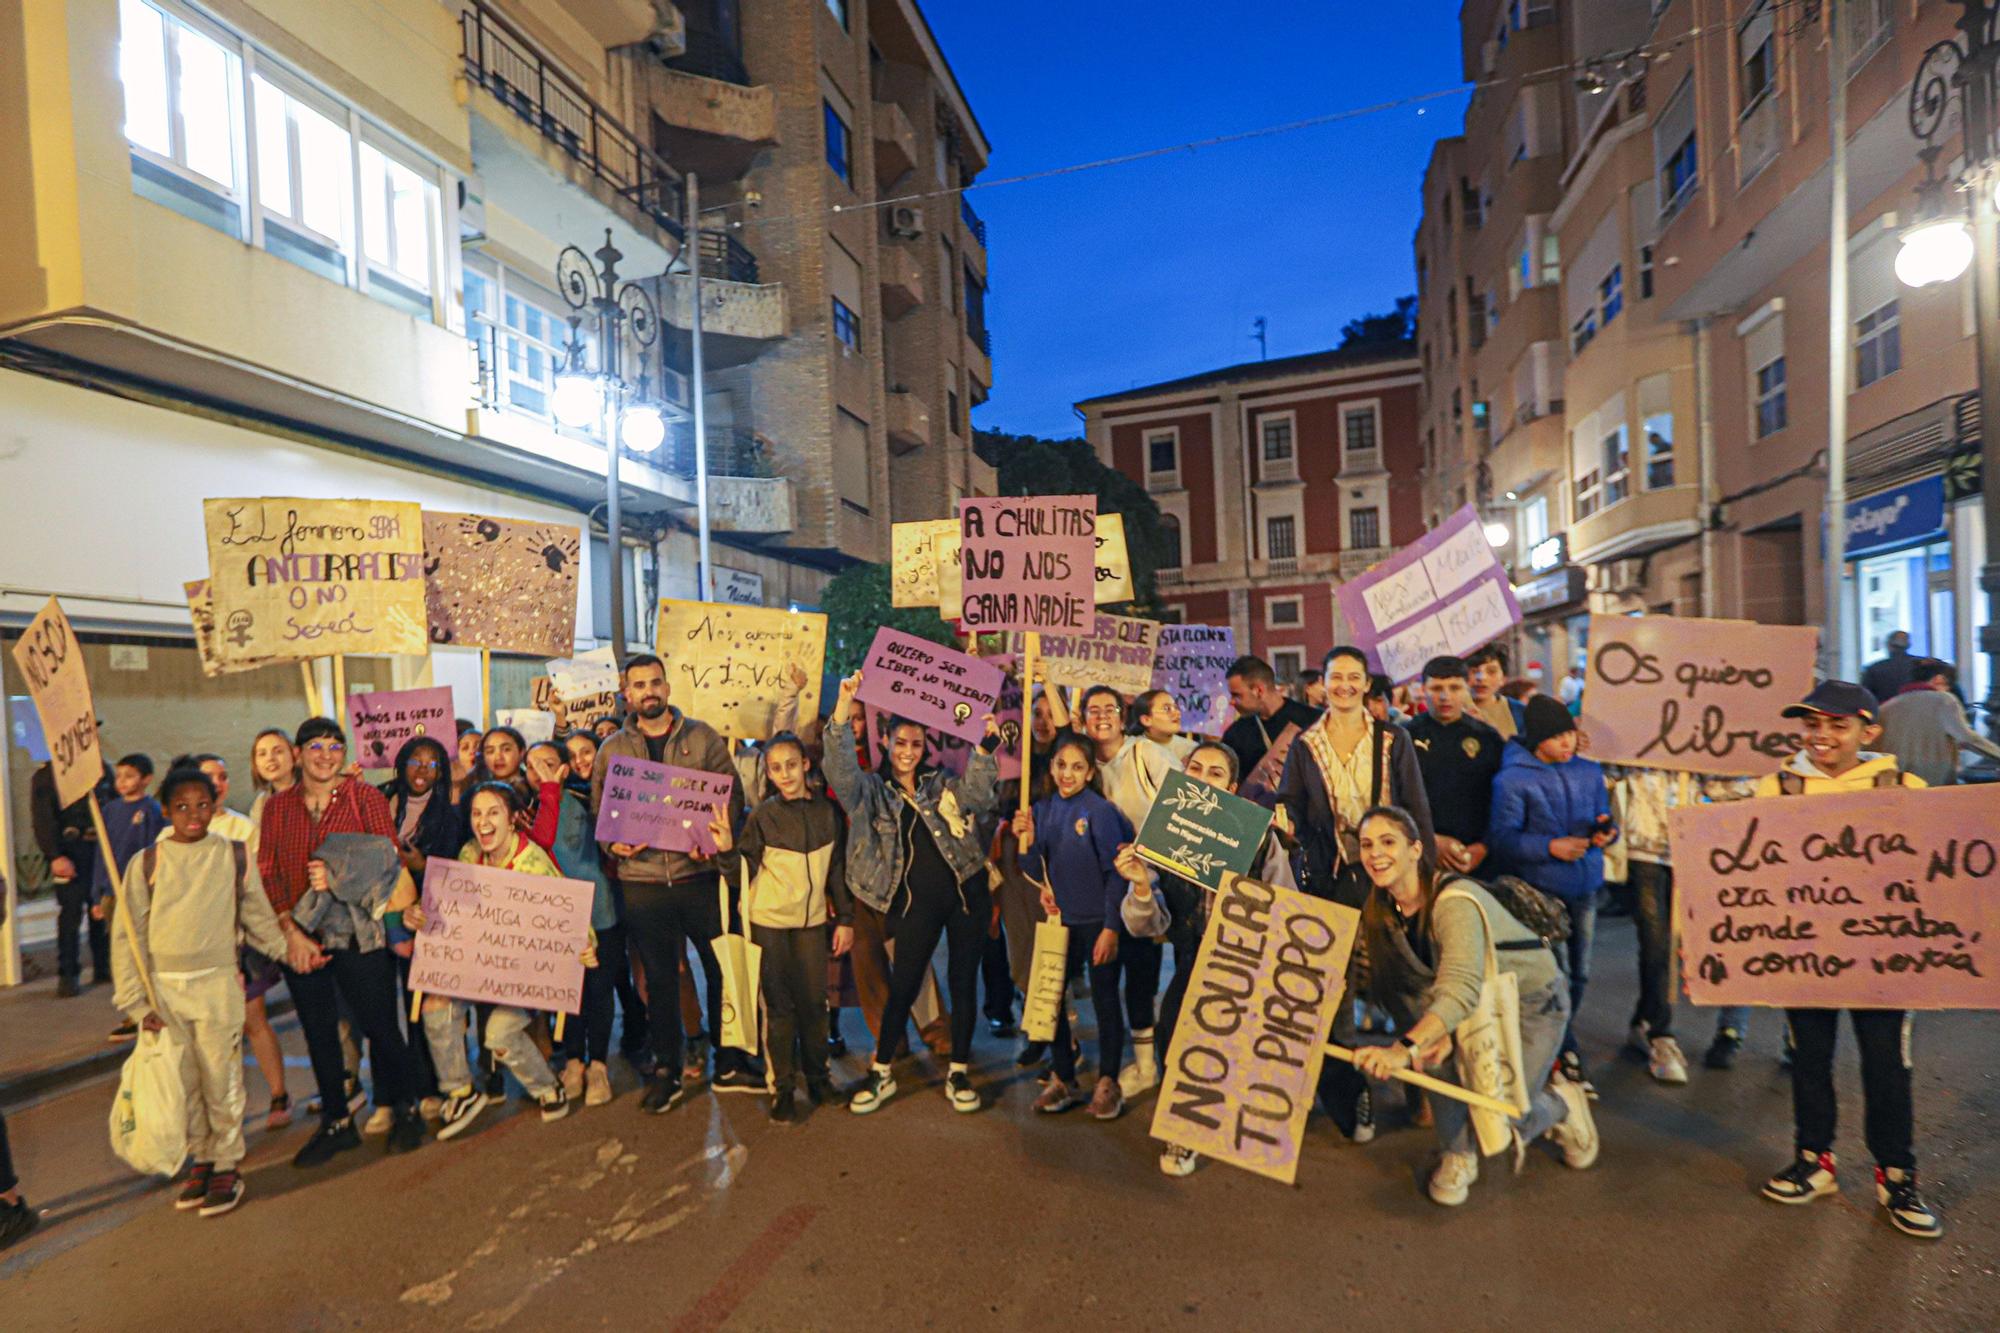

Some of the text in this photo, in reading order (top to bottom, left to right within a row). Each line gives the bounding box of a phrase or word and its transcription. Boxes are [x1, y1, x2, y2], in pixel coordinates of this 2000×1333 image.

[964, 506, 985, 538] A
[966, 548, 1004, 580] NO
[1023, 551, 1071, 580] NOS
[317, 584, 347, 605] NO
[963, 593, 1017, 626] GANA
[1118, 622, 1150, 645] QUE
[887, 641, 967, 677] QUIERO SER
[1595, 642, 1773, 698] Os quiero
[922, 673, 939, 684] NO
[920, 691, 947, 710] 2023
[1176, 689, 1212, 713] OÑO
[612, 764, 635, 777] QUE
[1710, 817, 1786, 874] La
[1927, 840, 1996, 882] NO
[434, 864, 574, 912] TODAS TENEMOS
[1718, 886, 1776, 906] era
[1884, 879, 1919, 902] ni
[429, 897, 572, 933] UNA AMIGA QUE
[1710, 915, 1817, 943] donde
[430, 920, 575, 956] FUE MALTRATADA
[423, 943, 464, 961] PERO
[534, 961, 555, 973] UN
[1700, 953, 1727, 985] ni
[1744, 953, 1855, 977] como
[416, 971, 577, 1003] AMIGO MALTRATADOR
[1170, 875, 1277, 1130] NO QUIERO
[1234, 913, 1336, 1150] TU PIROPO
